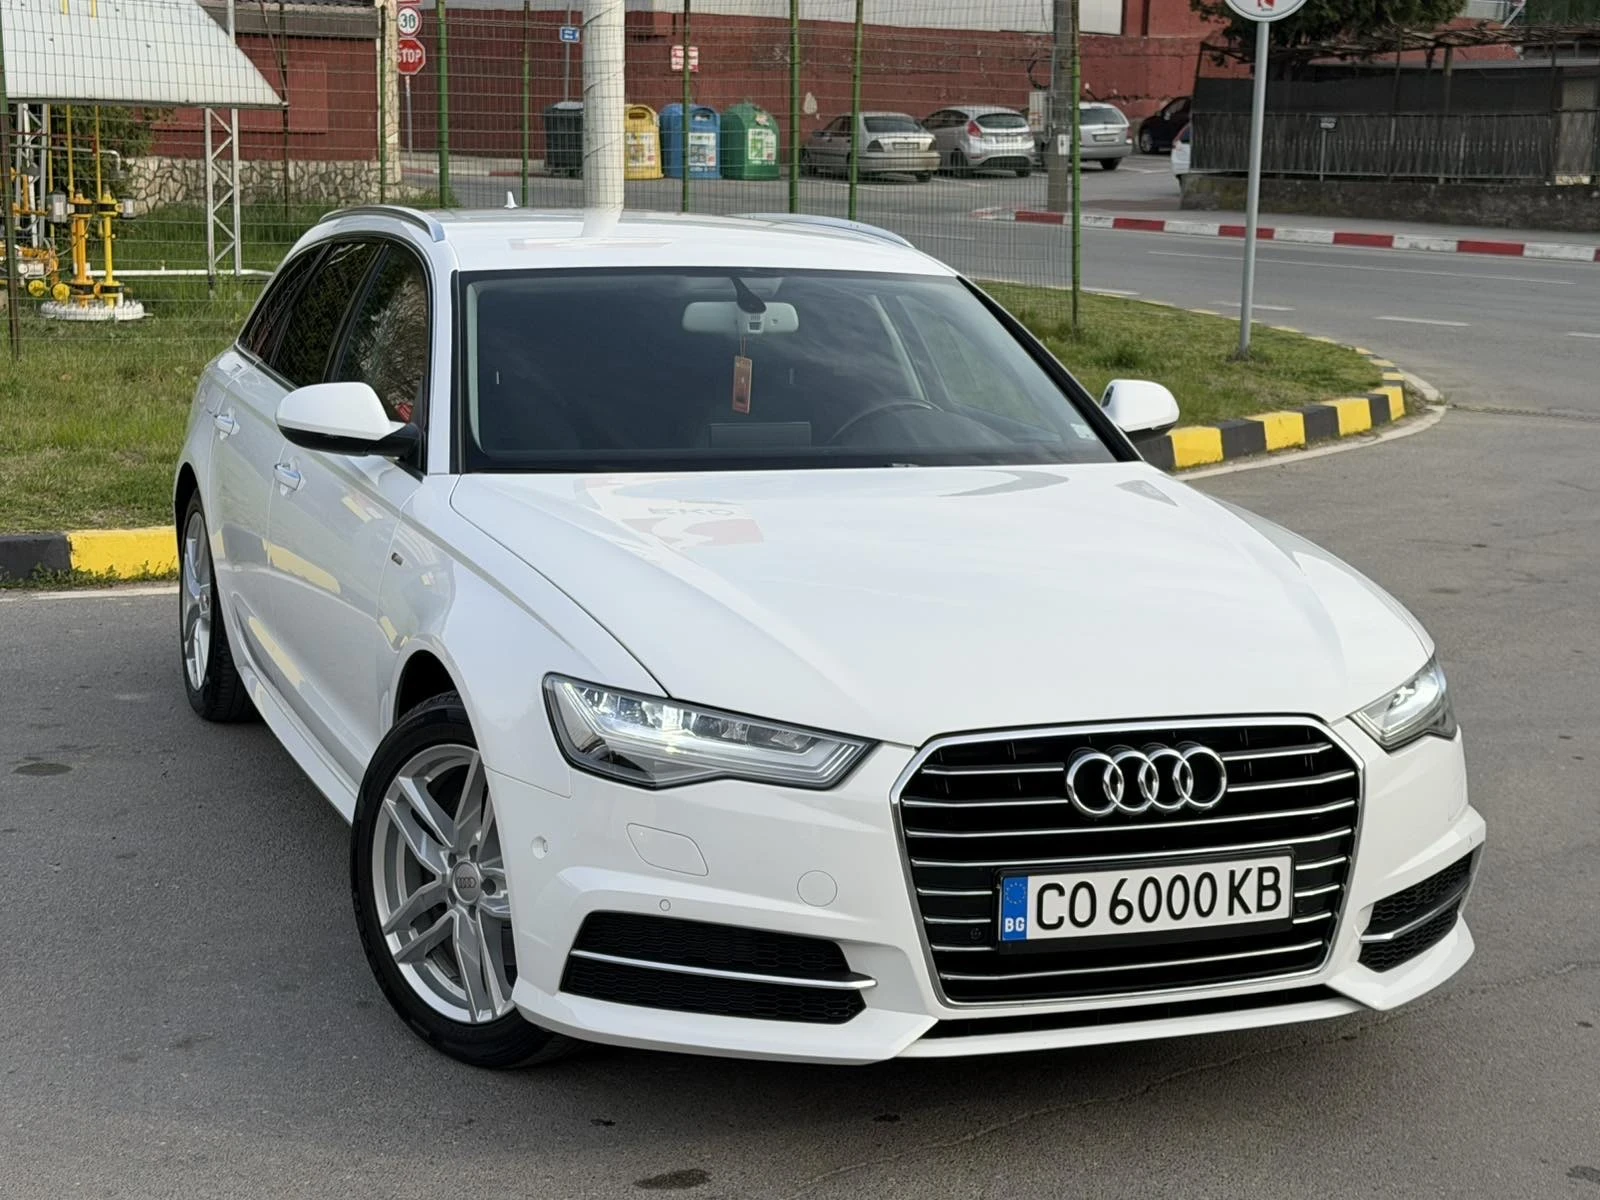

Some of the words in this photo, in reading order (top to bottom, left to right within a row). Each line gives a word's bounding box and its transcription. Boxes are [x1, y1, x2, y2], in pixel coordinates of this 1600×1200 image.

[400, 14, 416, 28] 30
[1036, 881, 1097, 930] CO
[1109, 871, 1217, 925] 6000
[1228, 865, 1281, 916] KB
[1004, 917, 1025, 932] BG
